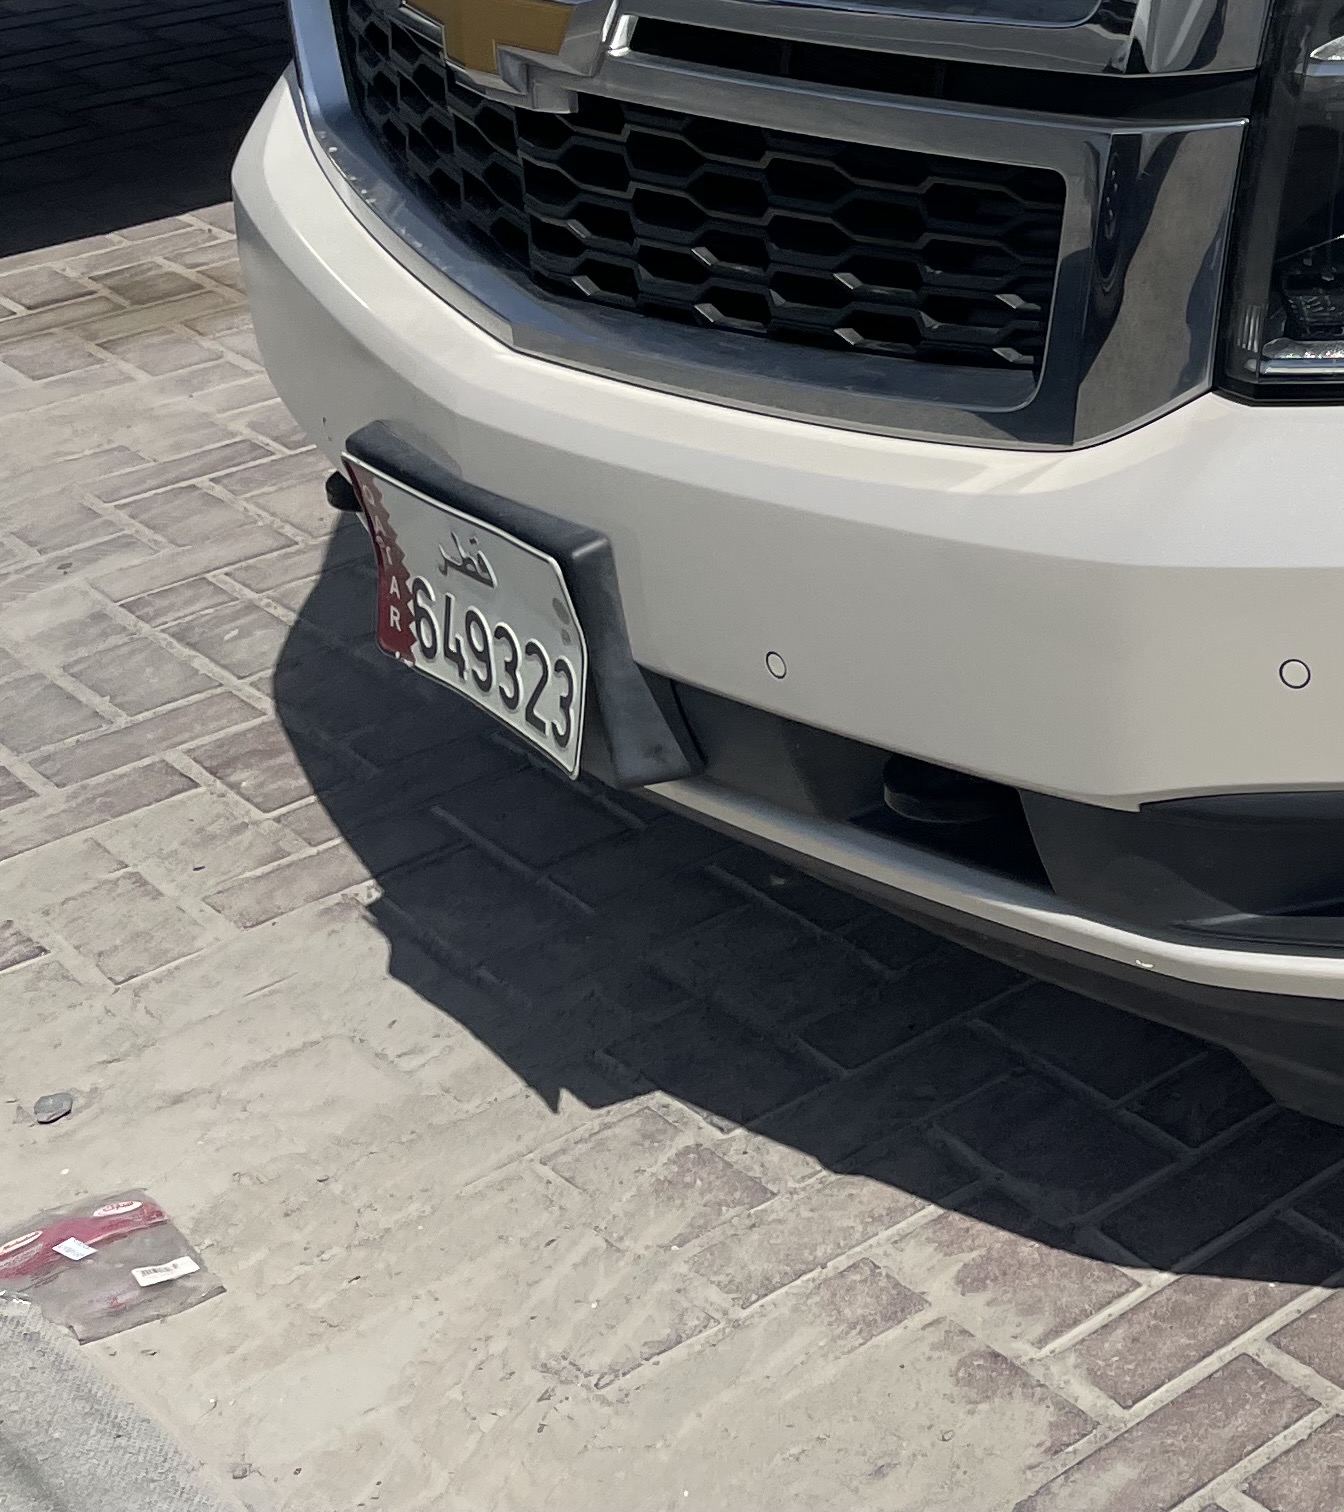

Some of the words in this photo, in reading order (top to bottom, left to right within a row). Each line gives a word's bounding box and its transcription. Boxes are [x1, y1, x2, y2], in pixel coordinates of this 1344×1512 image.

[361, 483, 402, 633] QATAR
[438, 530, 499, 589] قطر
[411, 576, 579, 750] 649323
